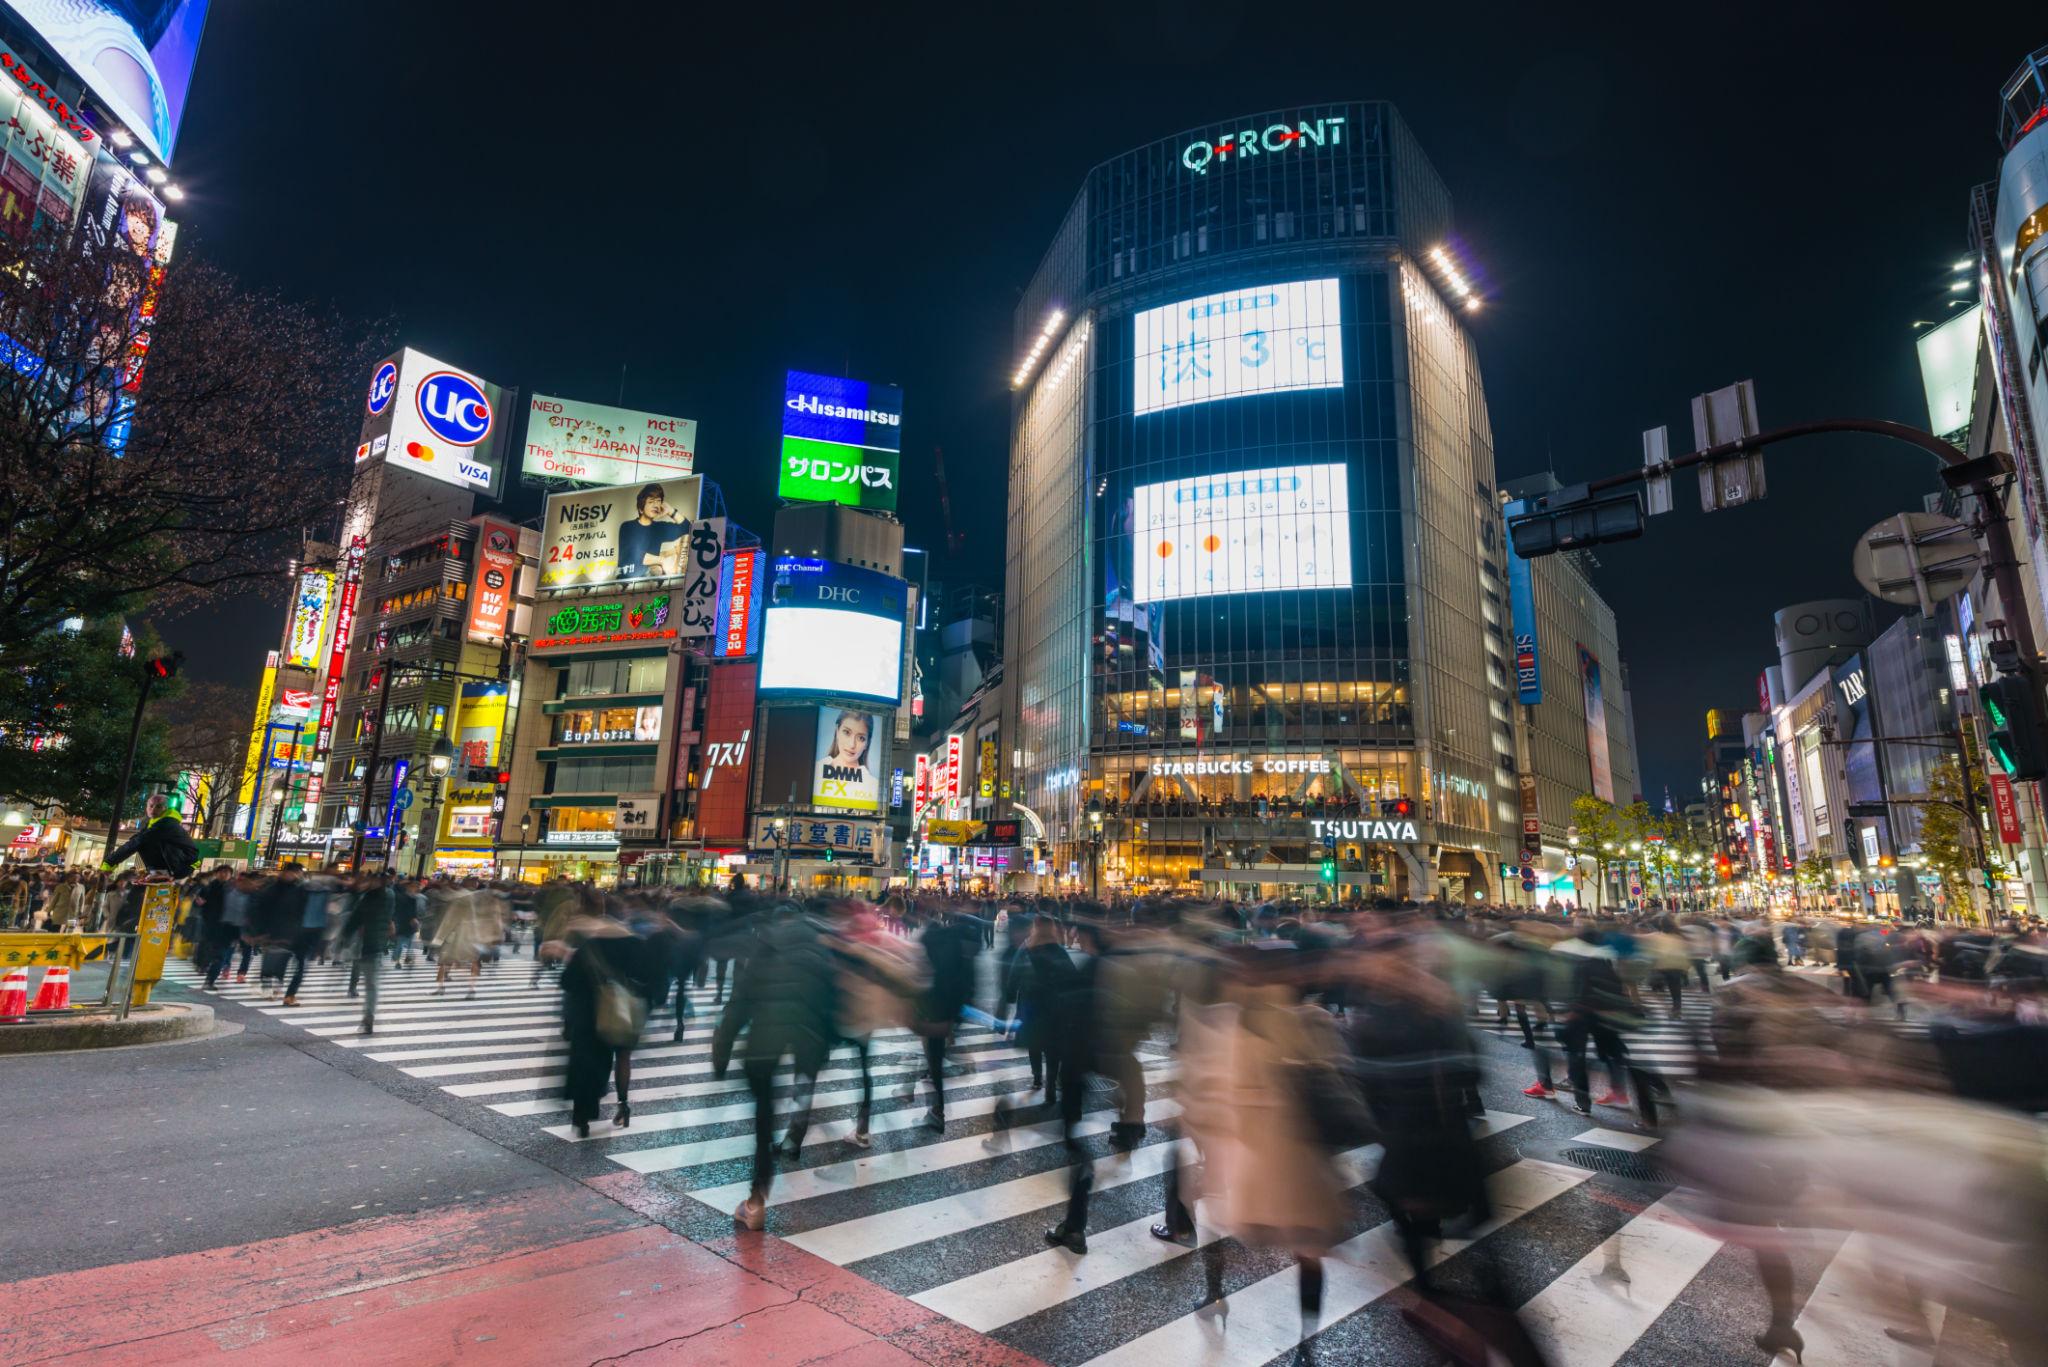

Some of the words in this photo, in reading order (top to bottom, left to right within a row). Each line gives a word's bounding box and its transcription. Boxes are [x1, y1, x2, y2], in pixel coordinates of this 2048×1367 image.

[0, 114, 77, 185] ゃぶ葉
[532, 399, 564, 414] NEO
[550, 416, 583, 430] CITY
[647, 419, 676, 433] nct
[593, 438, 641, 455] JAPAN
[646, 435, 676, 448] 3/29
[527, 444, 554, 458] The
[458, 462, 490, 483] VISA
[543, 460, 587, 476] Origin
[787, 455, 893, 490] サロンパス
[559, 503, 613, 524] Nissy
[559, 531, 607, 543] ベストアルバム
[547, 544, 574, 564] 2.4
[575, 551, 591, 560] ON
[593, 547, 615, 558] SALE
[793, 564, 823, 572] Channel
[683, 521, 722, 634] もんじゃ
[817, 585, 860, 603] DHC
[728, 557, 749, 650] 三千里薬品
[579, 610, 622, 633] 西村
[1516, 634, 1538, 692] SEIBU
[563, 729, 632, 745] Euphoria
[702, 729, 751, 790] クスリ
[1152, 760, 1254, 776] STARBUCKS
[1263, 760, 1330, 774] COFFEE
[822, 764, 863, 783] DMM
[820, 780, 848, 797] FX
[1310, 820, 1418, 841] TSUTAYA
